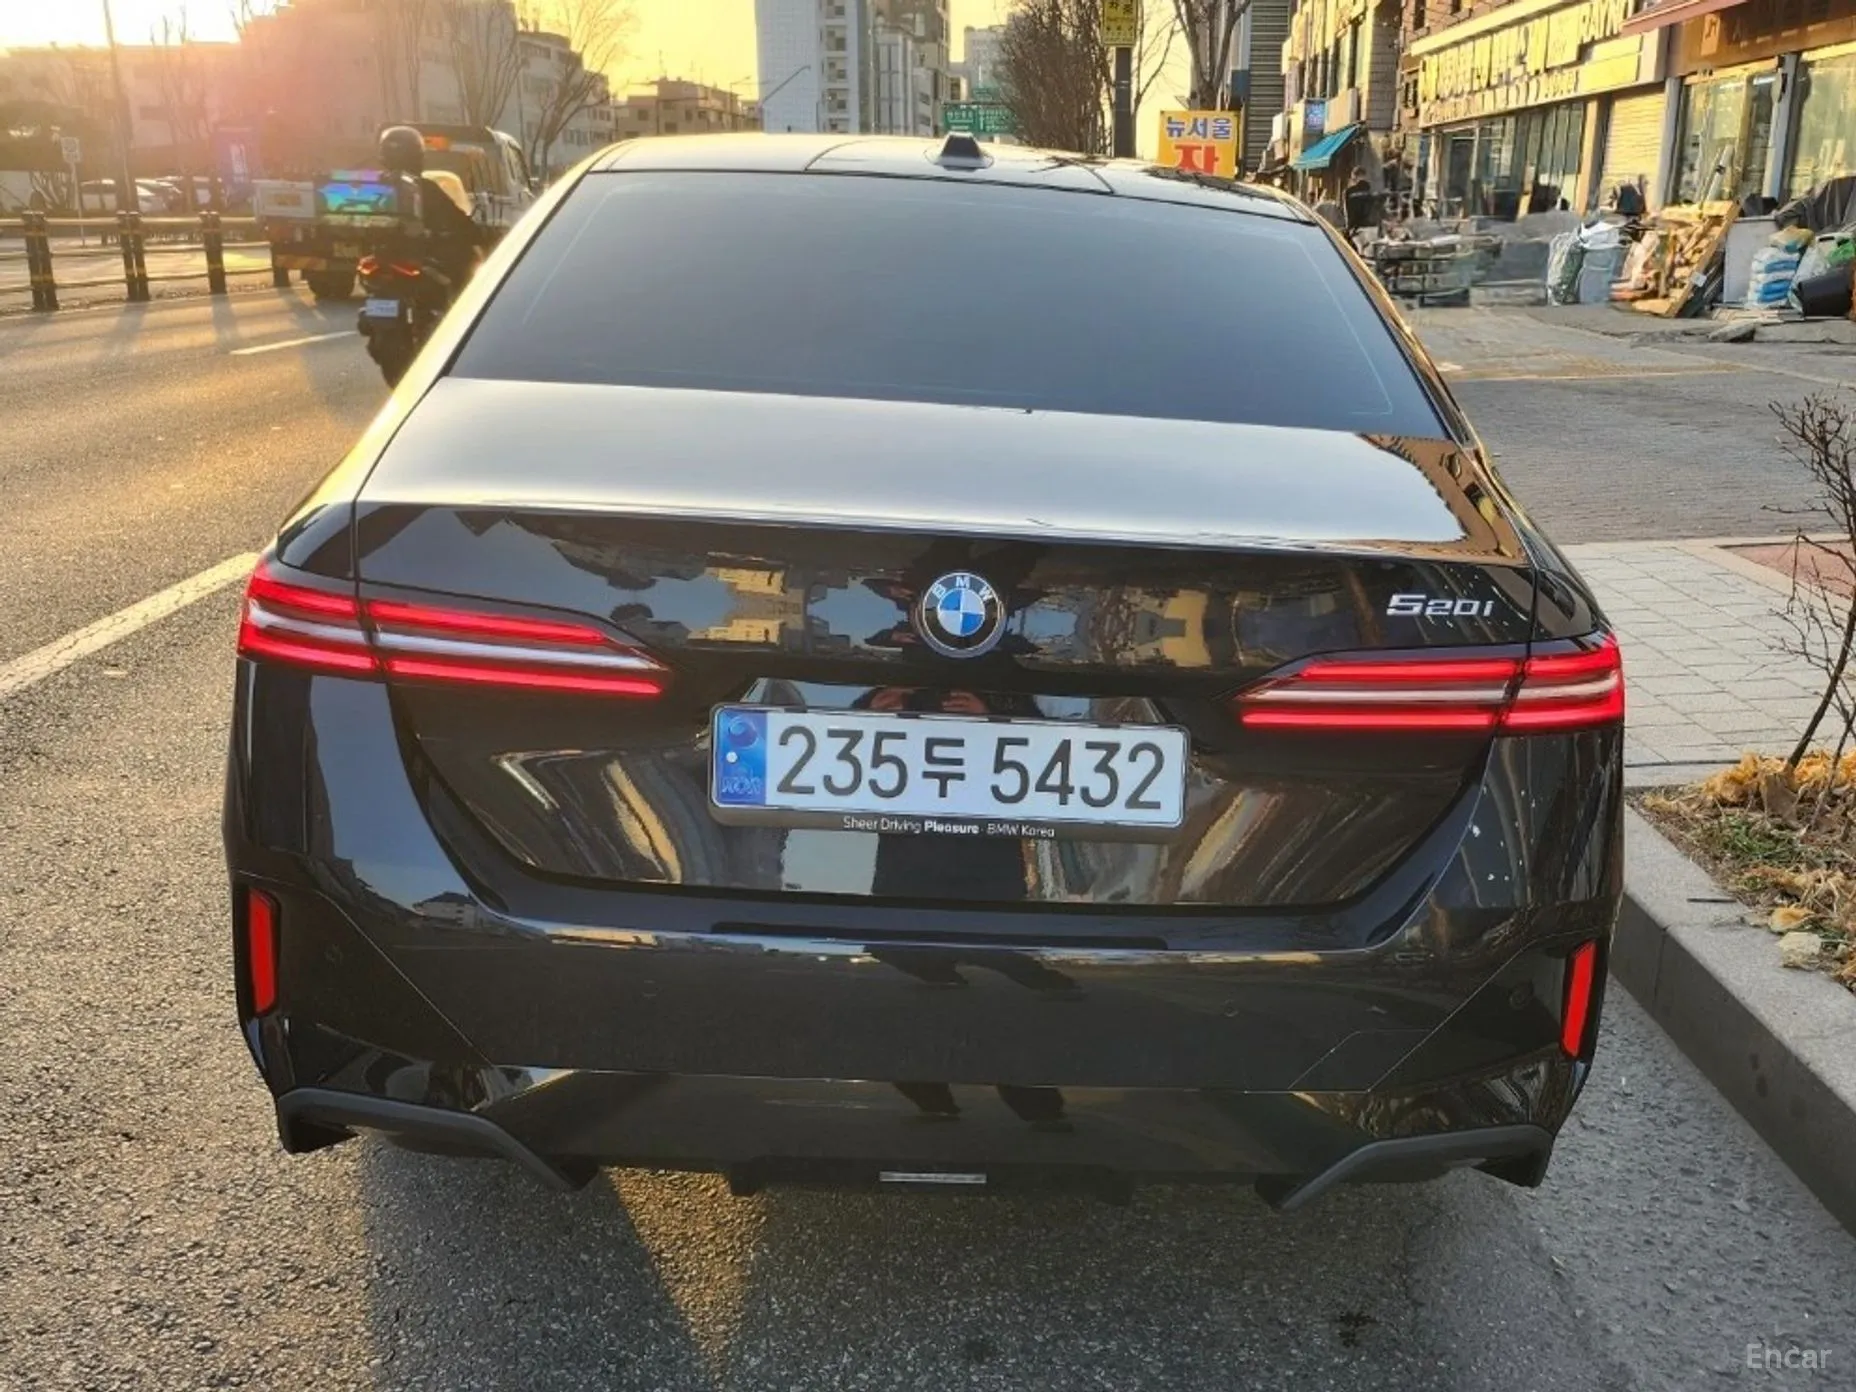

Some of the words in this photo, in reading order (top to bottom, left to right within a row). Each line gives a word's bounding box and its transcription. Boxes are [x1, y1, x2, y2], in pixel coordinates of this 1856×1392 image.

[1166, 116, 1231, 139] 뉴서울
[931, 575, 994, 601] BMW
[1386, 593, 1494, 616] 520i
[843, 815, 878, 830] Sheer
[881, 817, 922, 834] Driving
[924, 819, 980, 835] Pleasure
[987, 822, 1019, 836] BMW
[1021, 824, 1055, 838] Korea
